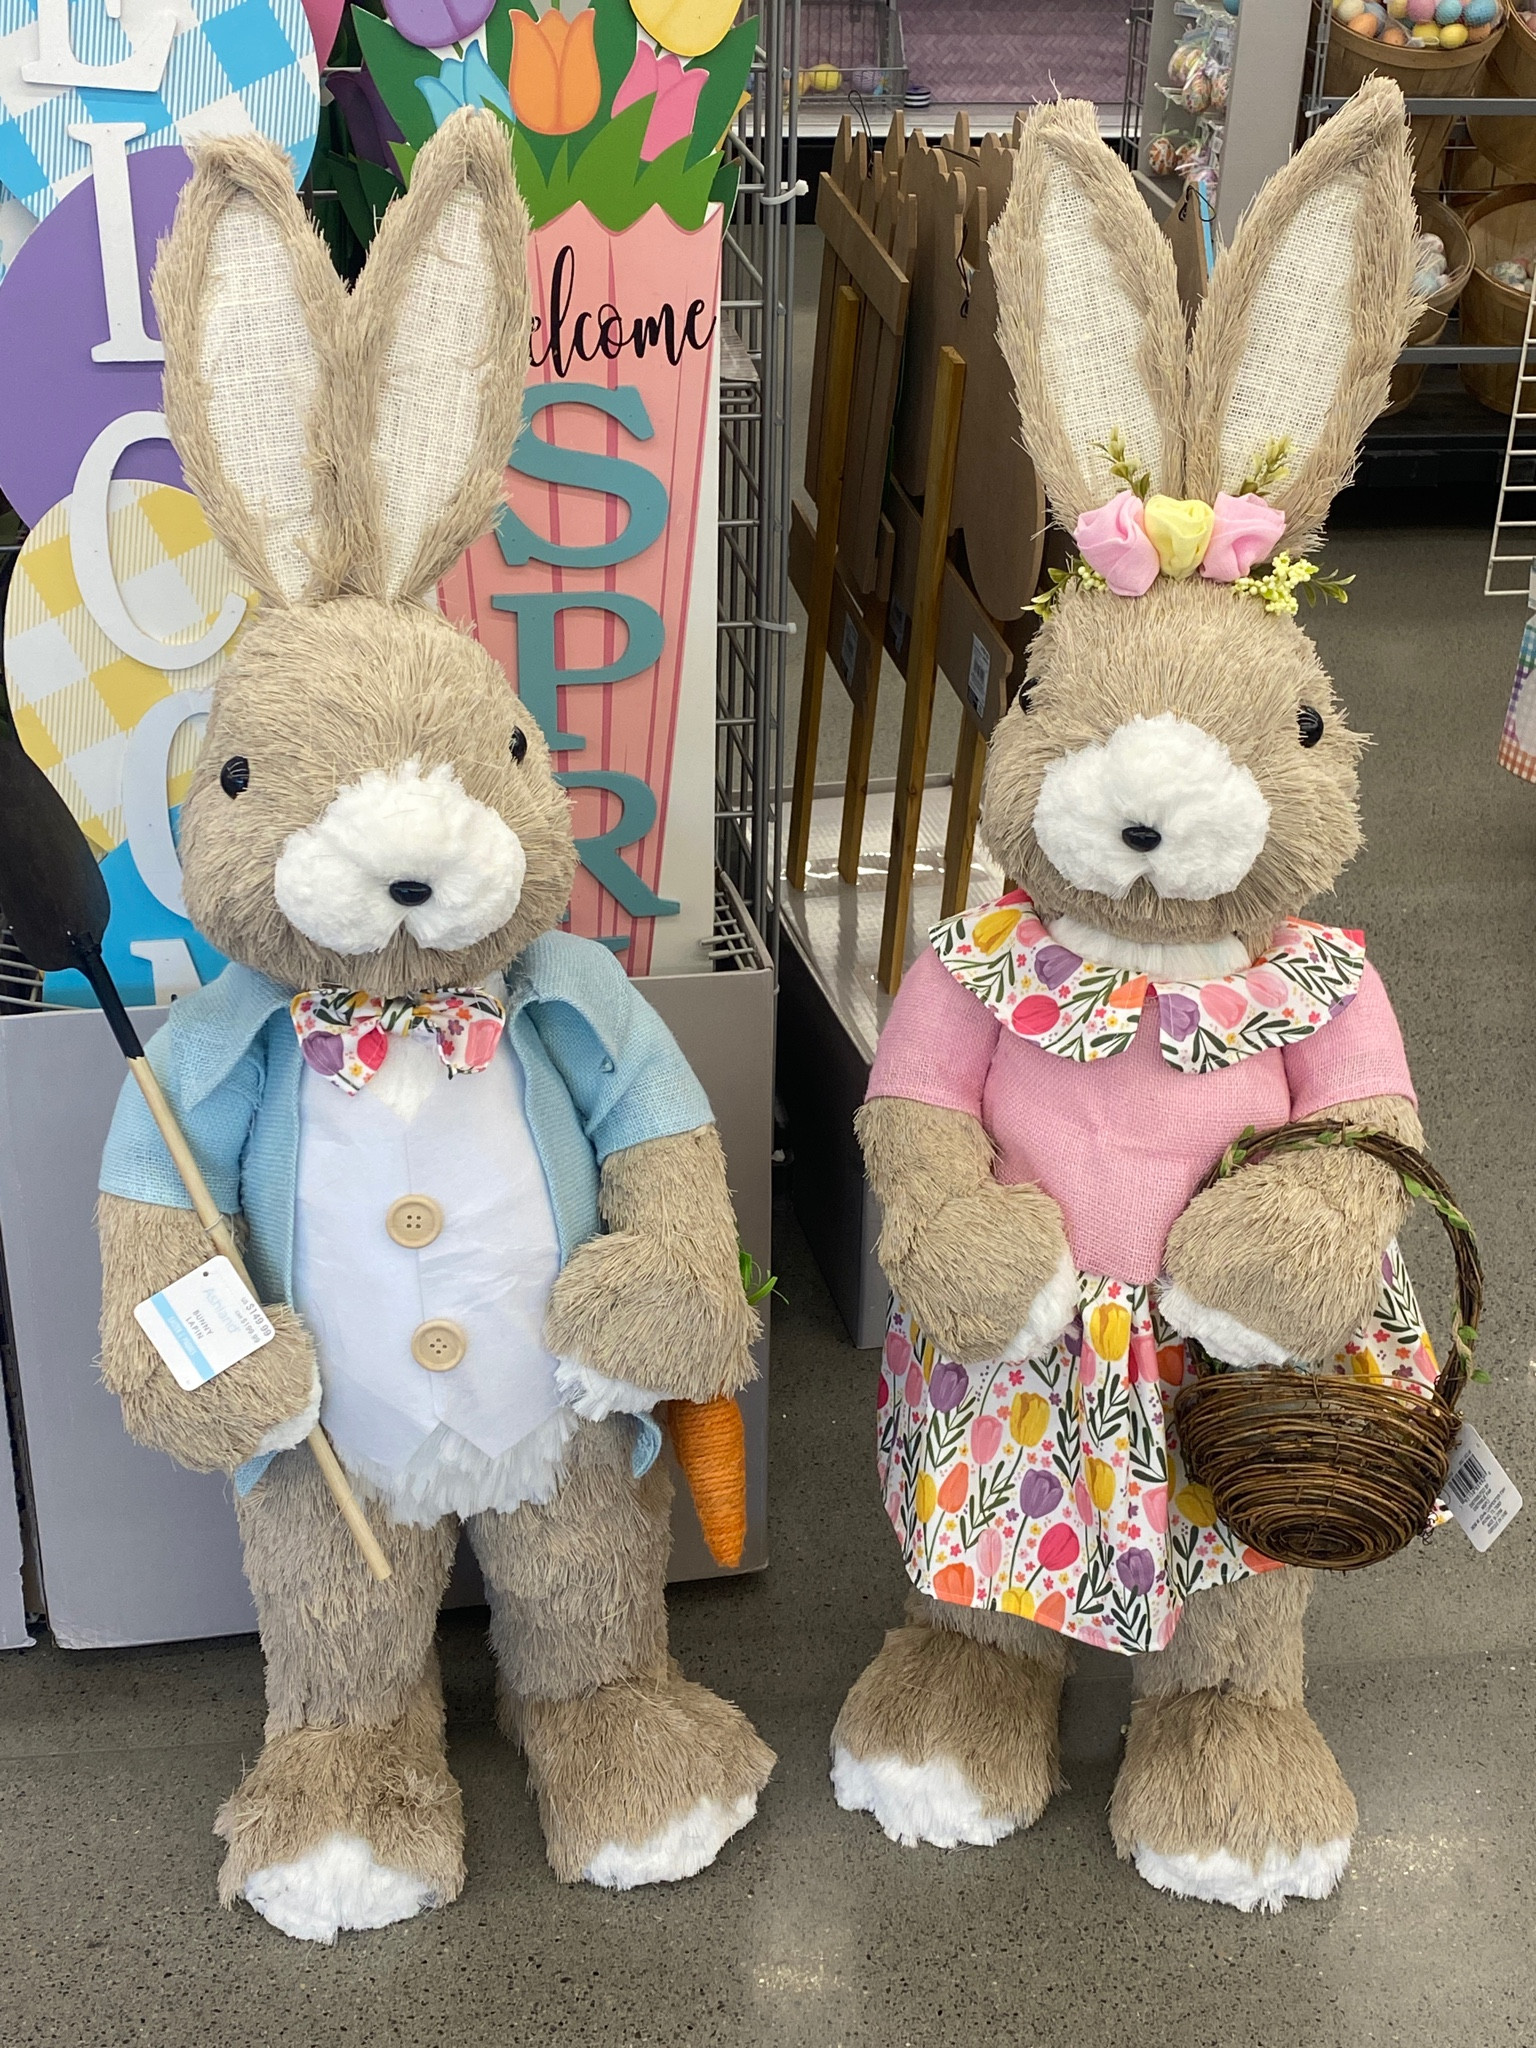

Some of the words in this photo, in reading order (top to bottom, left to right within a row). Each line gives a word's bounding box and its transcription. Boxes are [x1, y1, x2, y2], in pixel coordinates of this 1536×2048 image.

[529, 245, 717, 378] elcome
[491, 383, 681, 955] SPR
[186, 1317, 204, 1339] LAPIN
[193, 1309, 214, 1335] BUNNY
[203, 1288, 238, 1333] Ashland
[246, 1303, 272, 1336] $149.99
